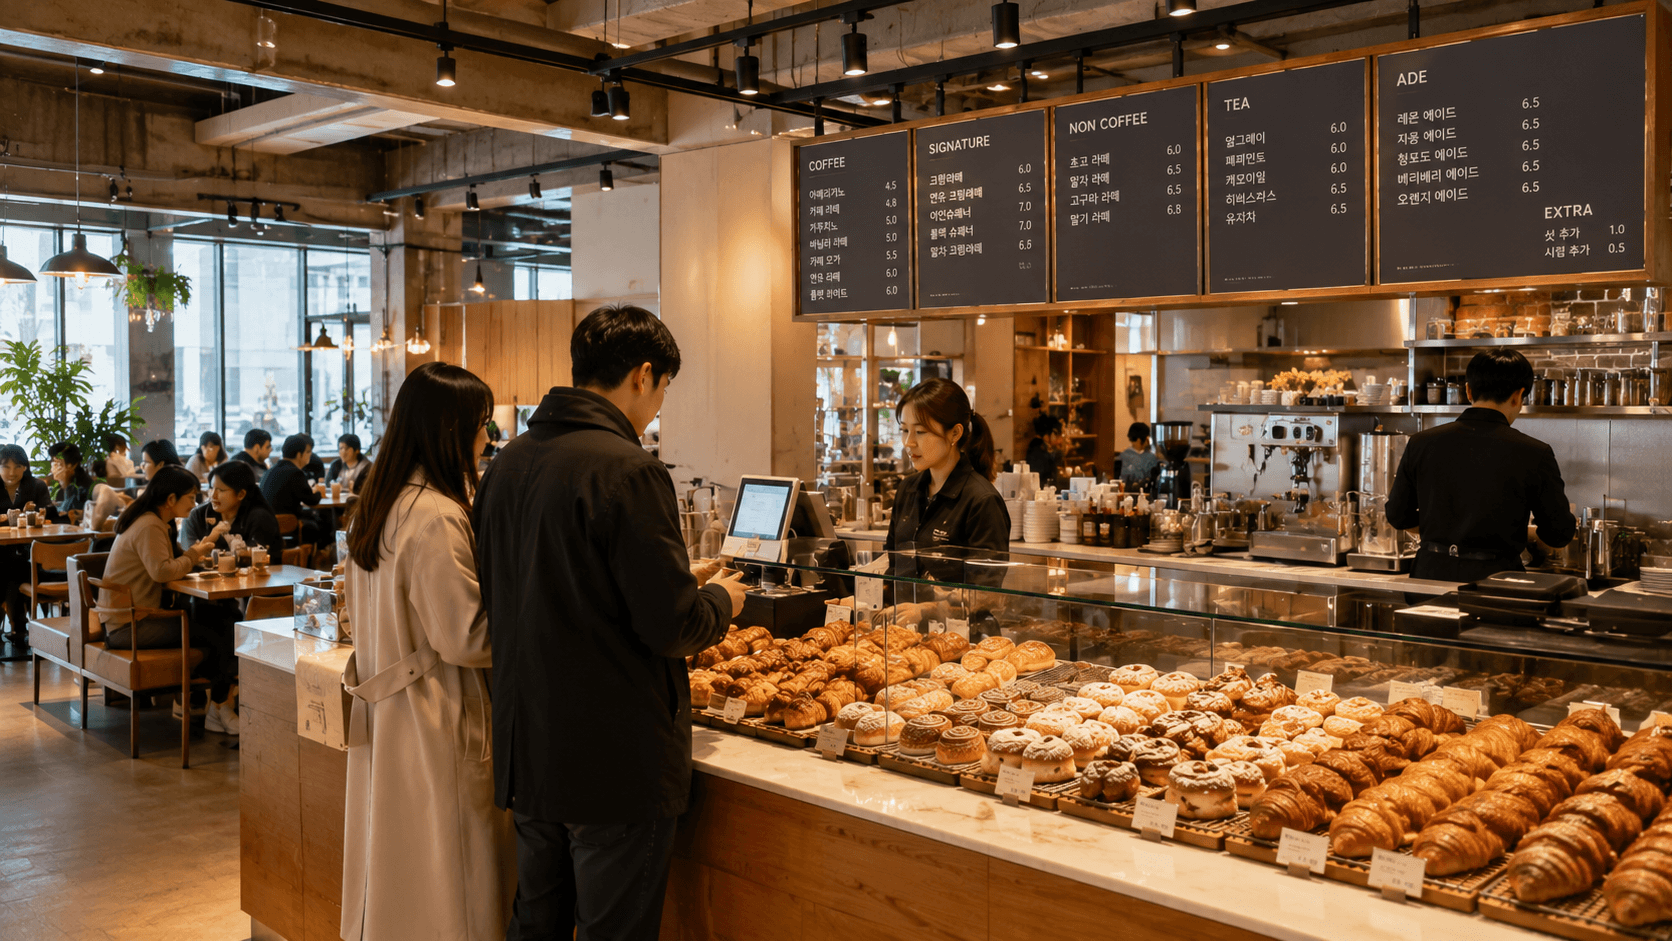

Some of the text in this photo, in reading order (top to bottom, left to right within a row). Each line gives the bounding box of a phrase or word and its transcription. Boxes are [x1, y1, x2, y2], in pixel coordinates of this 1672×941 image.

[1397, 70, 1427, 86] ADE
[1224, 97, 1250, 111] TEA
[1398, 97, 1539, 125] 레몬 에이드 6.5
[1070, 112, 1147, 134] NON COFFEE
[1331, 122, 1346, 133] 6.0
[1424, 128, 1456, 142] 에이드
[1522, 118, 1539, 130] 6.5
[929, 135, 990, 154] SIGNATURE
[1167, 144, 1181, 155] 6.0
[1331, 142, 1346, 153] 6.0
[1522, 139, 1539, 151] 6.5
[809, 157, 845, 171] COFFEE
[1019, 163, 1031, 174] 6.0
[1167, 164, 1181, 175] 6.5
[1331, 162, 1346, 173] 6.0
[1446, 167, 1479, 180] 에이드
[1522, 160, 1539, 172] 6.5
[885, 181, 896, 190] 4.5
[1019, 183, 1031, 193] 6.5
[1167, 184, 1181, 195] 6.5
[1331, 183, 1346, 194] 6.5
[1398, 181, 1539, 205] 오렌지 에이드 6.5
[886, 198, 896, 207] 4.8
[1019, 202, 1031, 211] 7.0
[1167, 204, 1181, 214] 6.8
[1331, 203, 1346, 214] 6.5
[1545, 204, 1592, 219] EXTRA
[1019, 220, 1031, 230] 7.0
[1559, 227, 1580, 240] 추가
[1610, 224, 1624, 234] 1.0
[1569, 244, 1590, 256] 추가
[1609, 243, 1625, 253] 0.5
[886, 268, 897, 277] 6.0
[886, 286, 897, 295] 6.0
